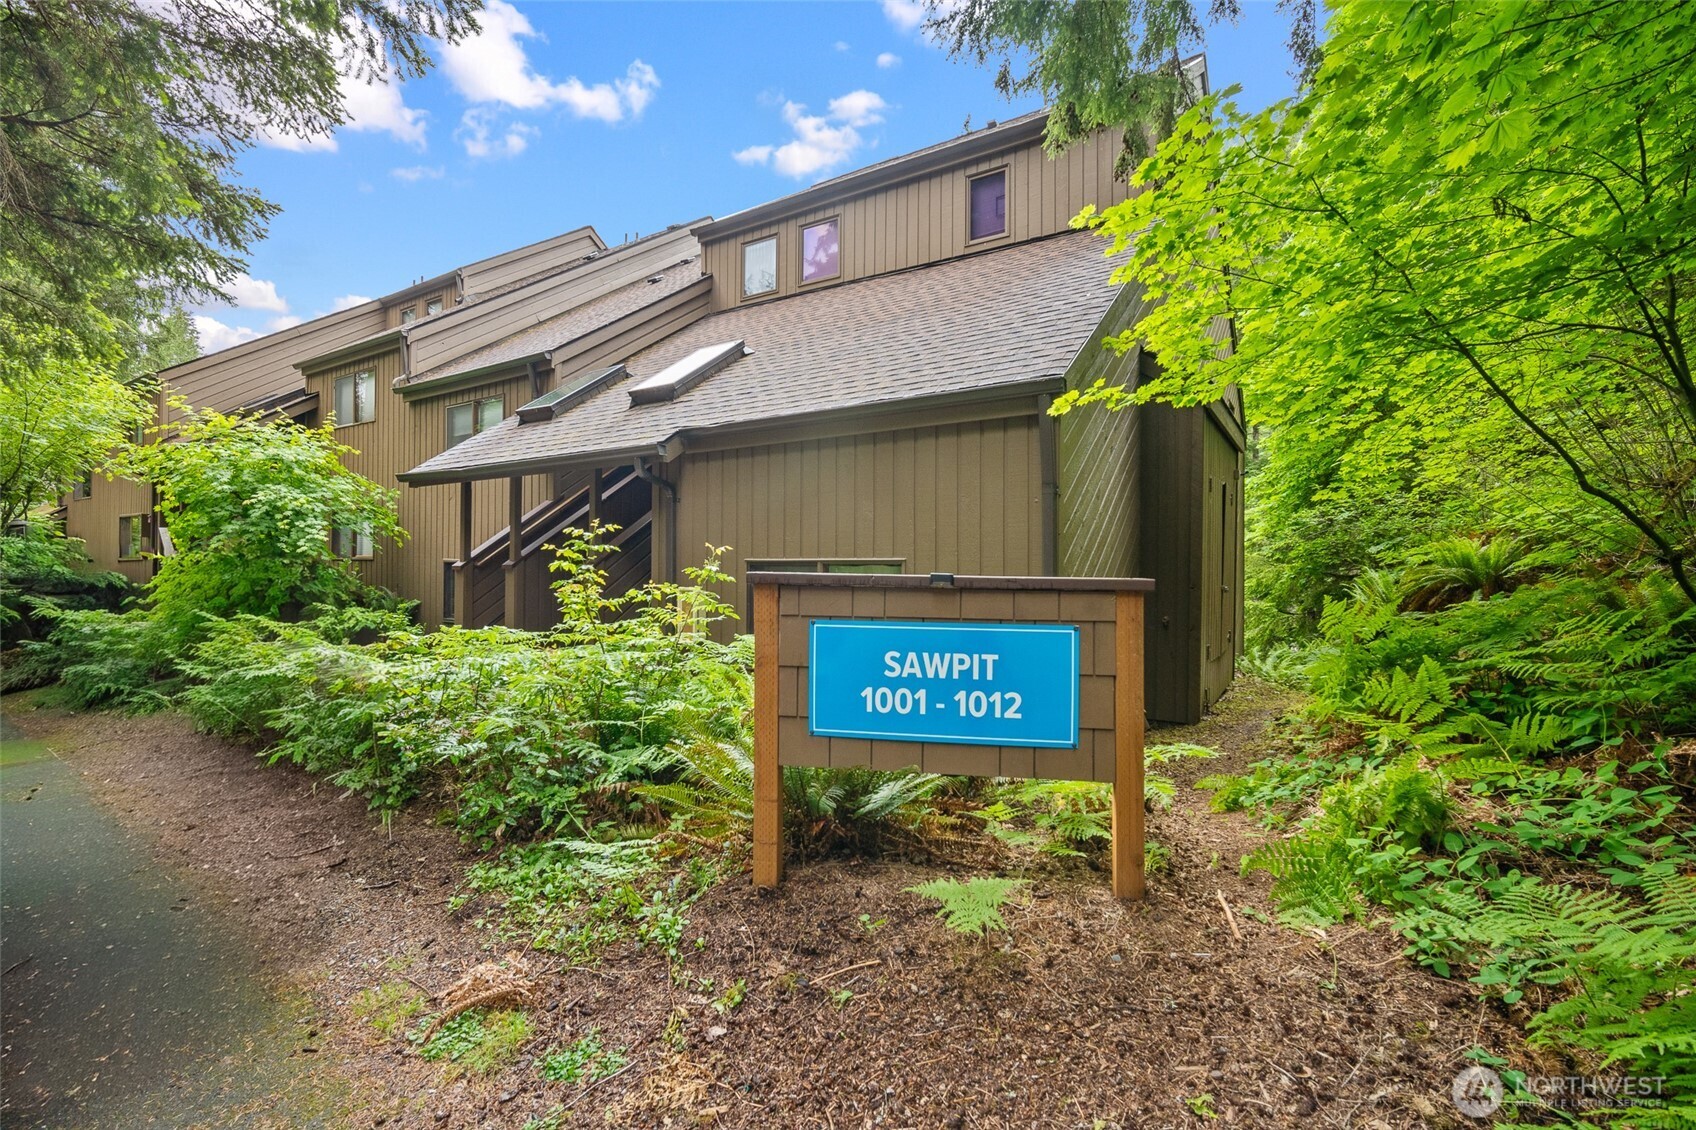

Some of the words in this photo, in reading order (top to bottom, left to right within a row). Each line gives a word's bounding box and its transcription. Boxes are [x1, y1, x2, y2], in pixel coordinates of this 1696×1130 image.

[884, 651, 998, 680] SAWPIT
[860, 687, 926, 715] 1001
[954, 690, 1022, 719] 1012
